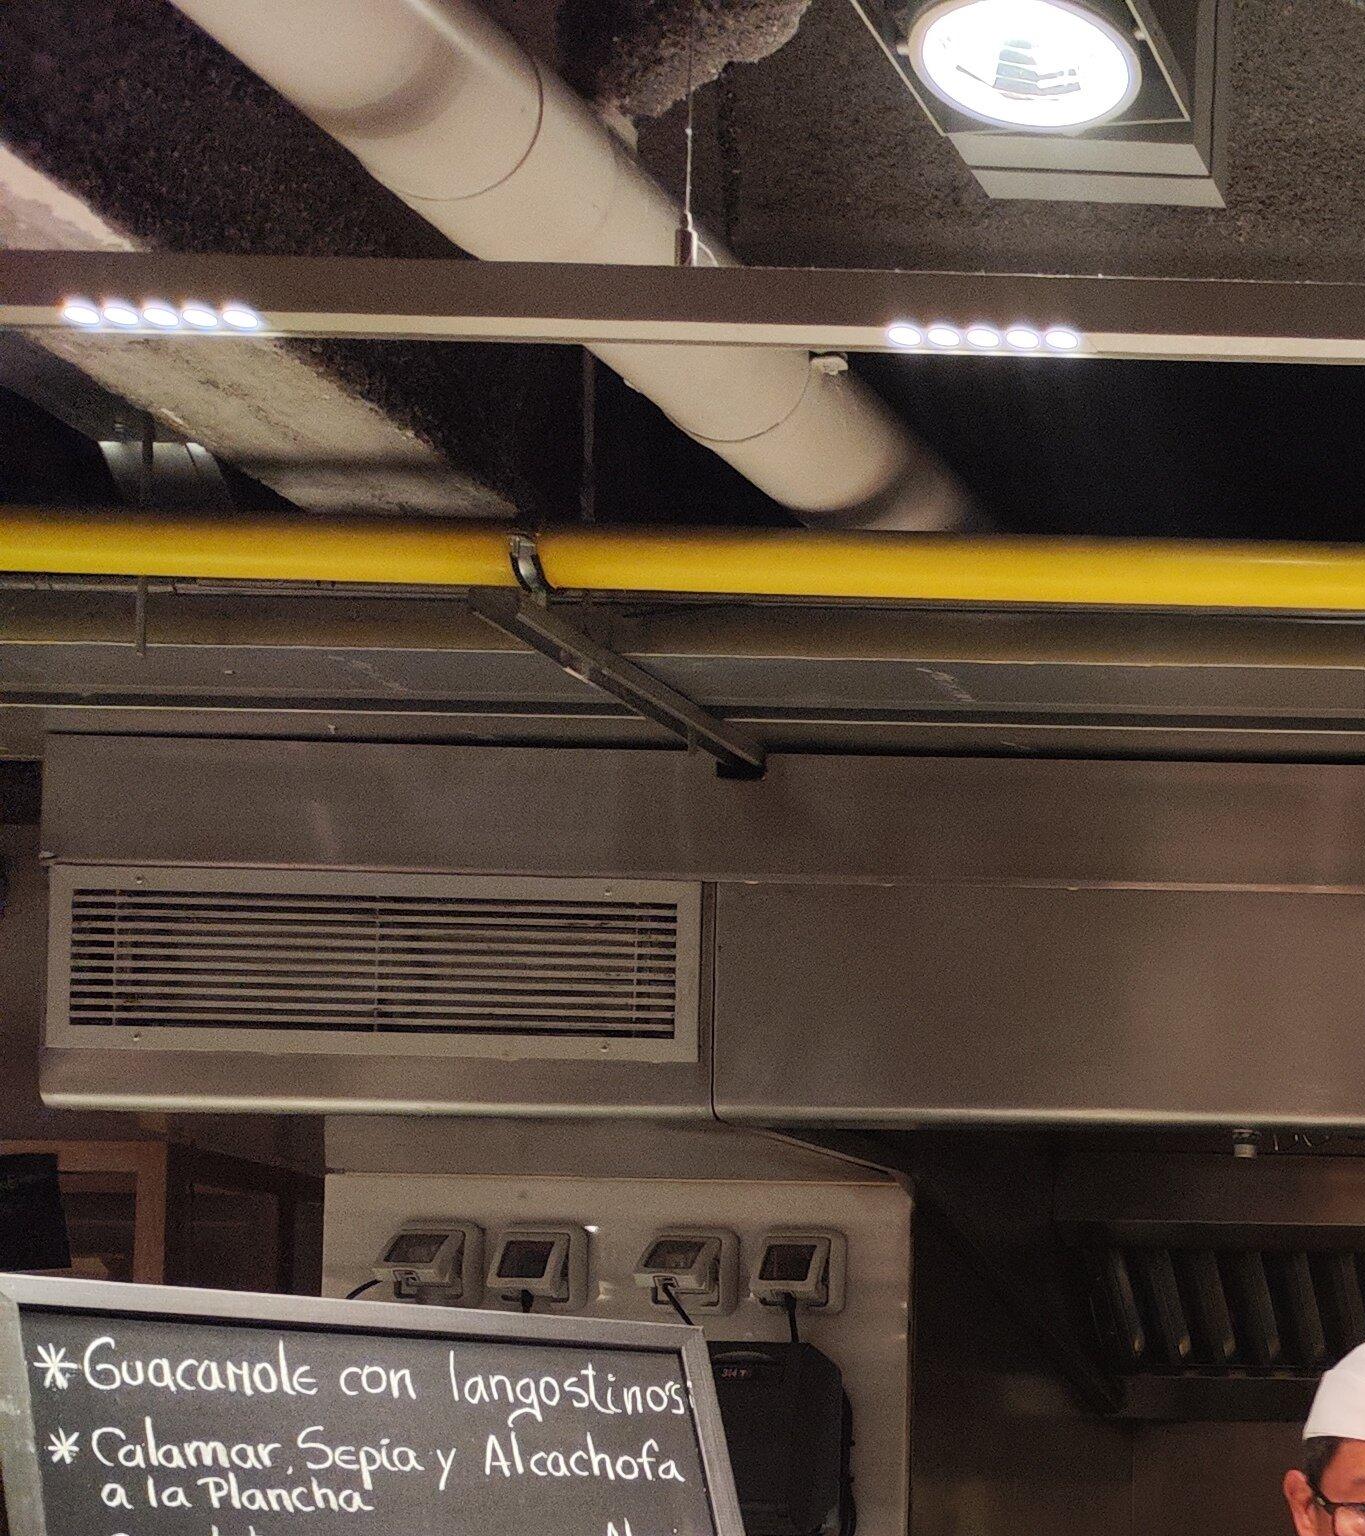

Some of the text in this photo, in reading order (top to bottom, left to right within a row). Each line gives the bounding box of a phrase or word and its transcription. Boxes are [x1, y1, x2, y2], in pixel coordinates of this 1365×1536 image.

[339, 1365, 417, 1400] con
[436, 1447, 457, 1491] y
[484, 1430, 686, 1483] Alcachofa
[100, 1471, 375, 1513] a la Plancha
